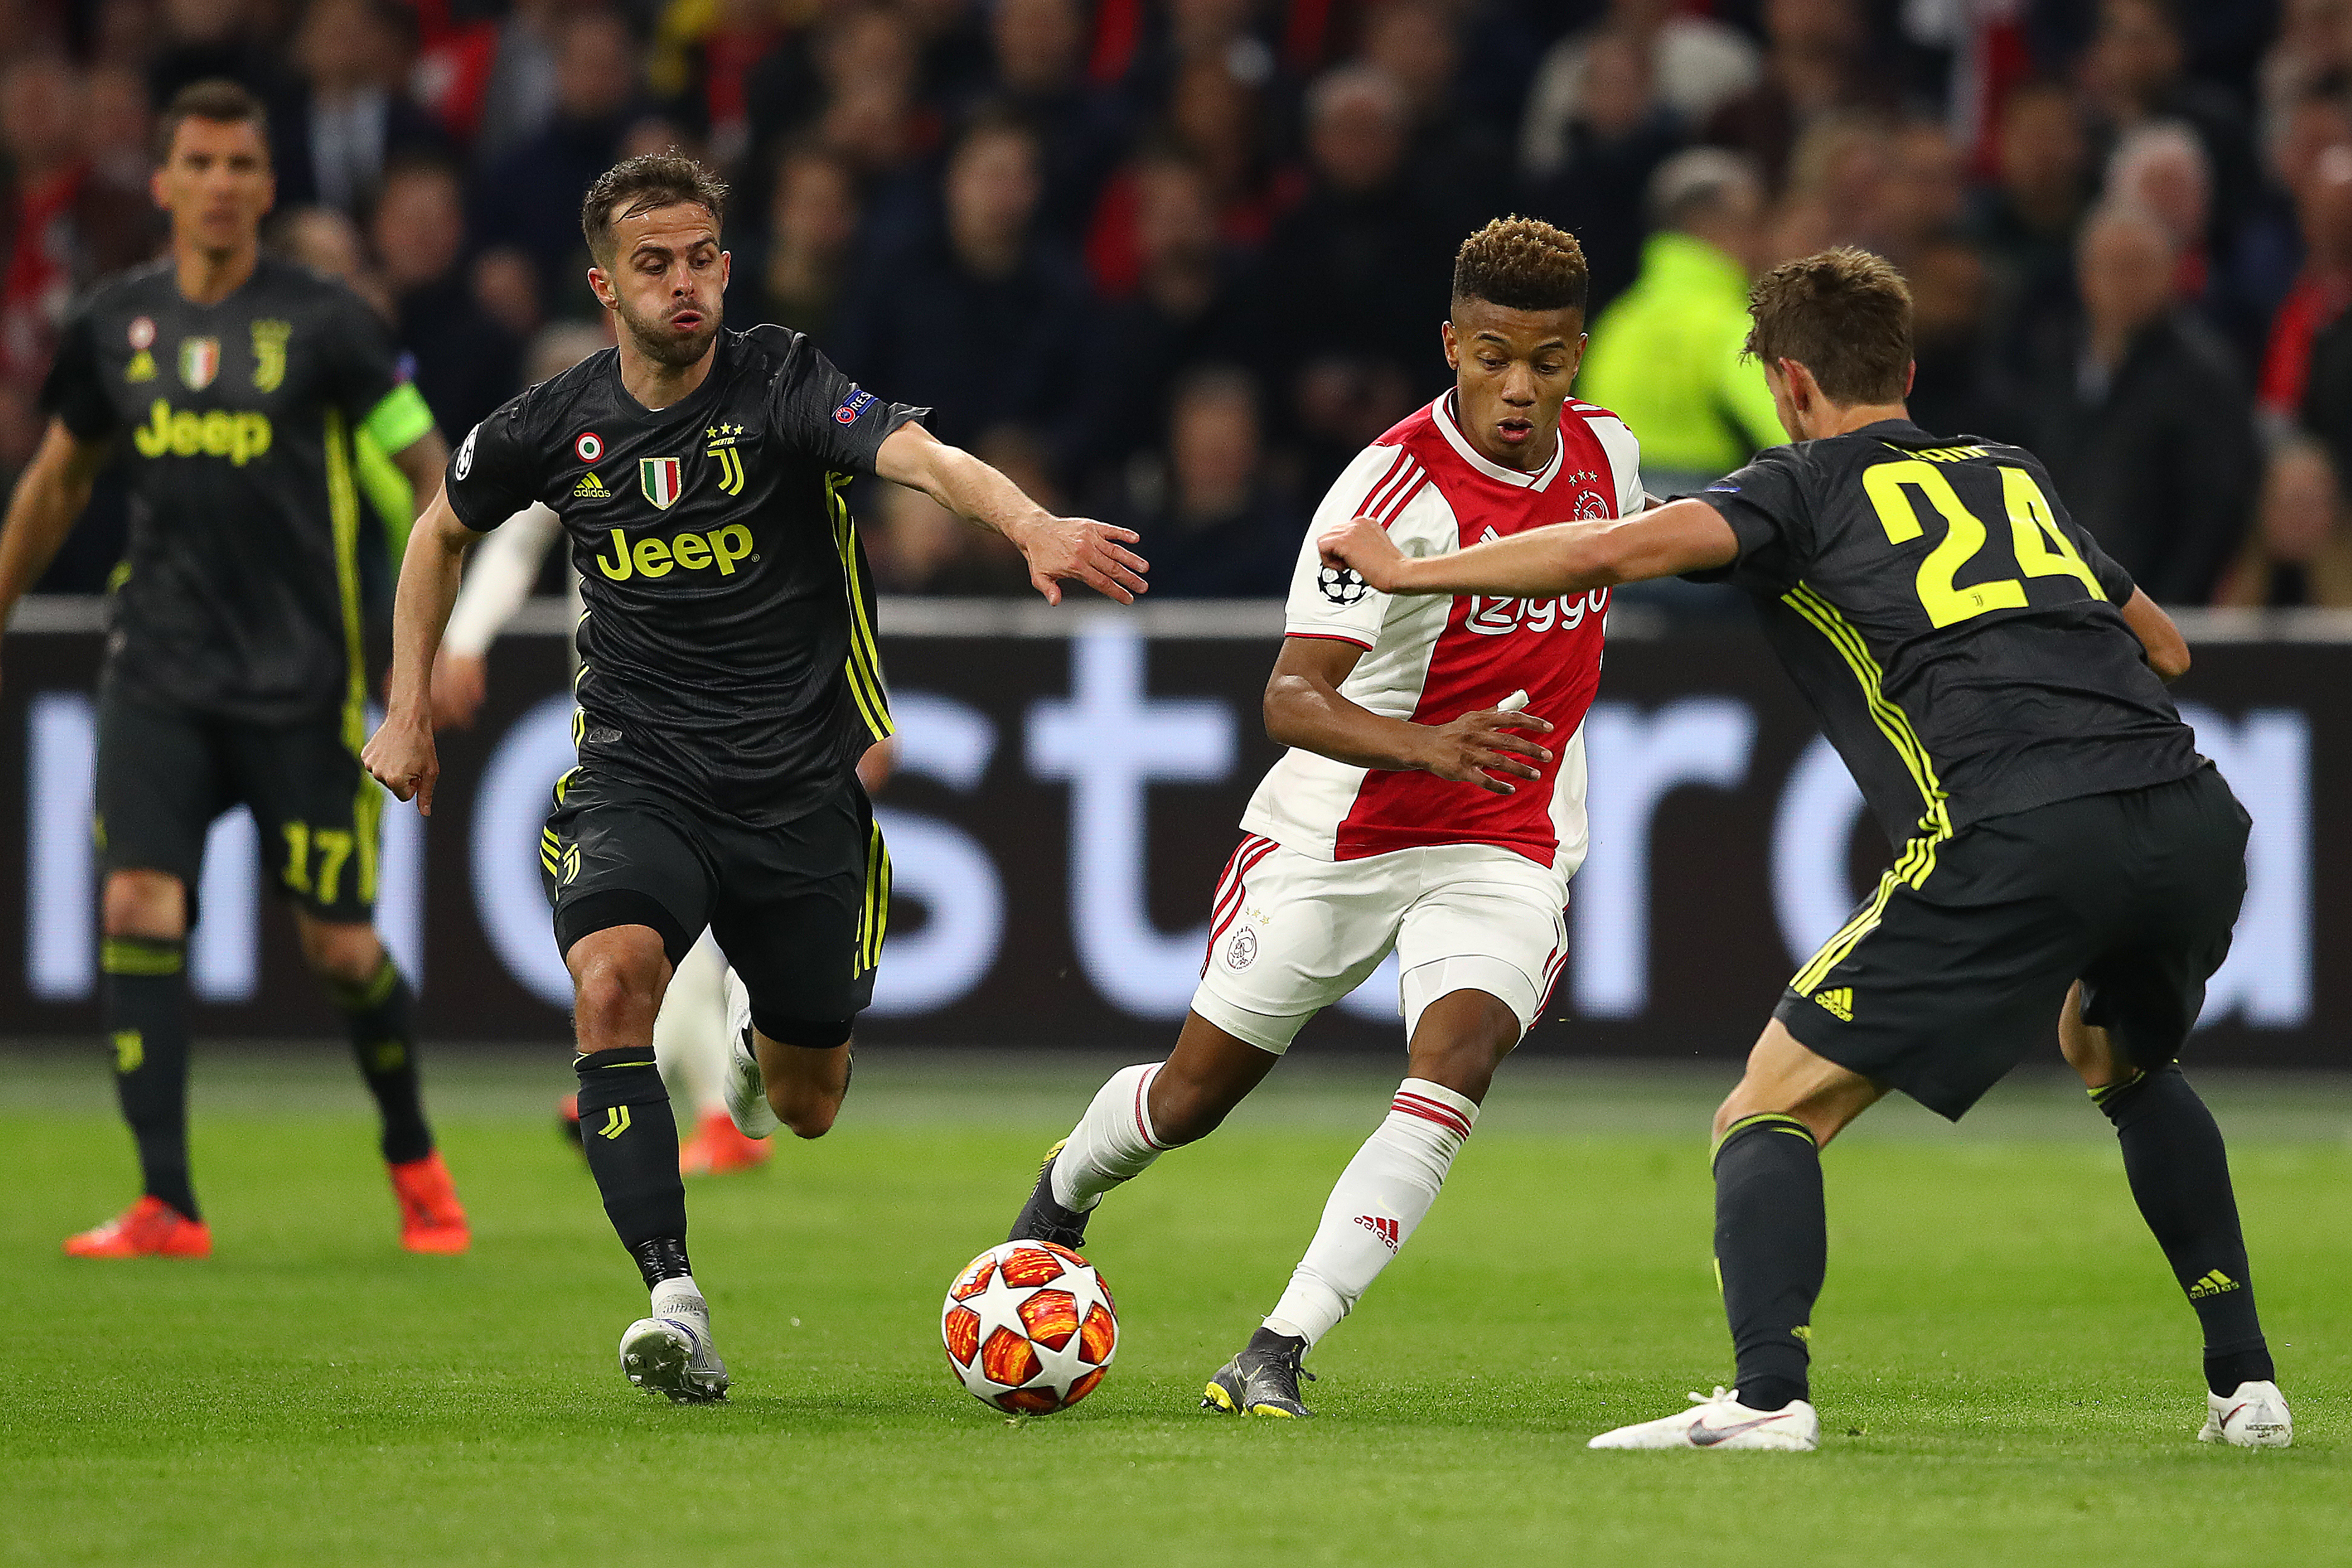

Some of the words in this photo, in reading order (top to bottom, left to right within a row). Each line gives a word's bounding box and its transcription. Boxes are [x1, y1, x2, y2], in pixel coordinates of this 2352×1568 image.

[850, 392, 874, 411] RES
[134, 398, 272, 466] Jeep
[574, 488, 611, 497] adidas
[596, 524, 753, 581] Jeep
[1862, 459, 2108, 629] 24
[282, 821, 352, 904] 17
[1354, 1217, 1398, 1255] adidas
